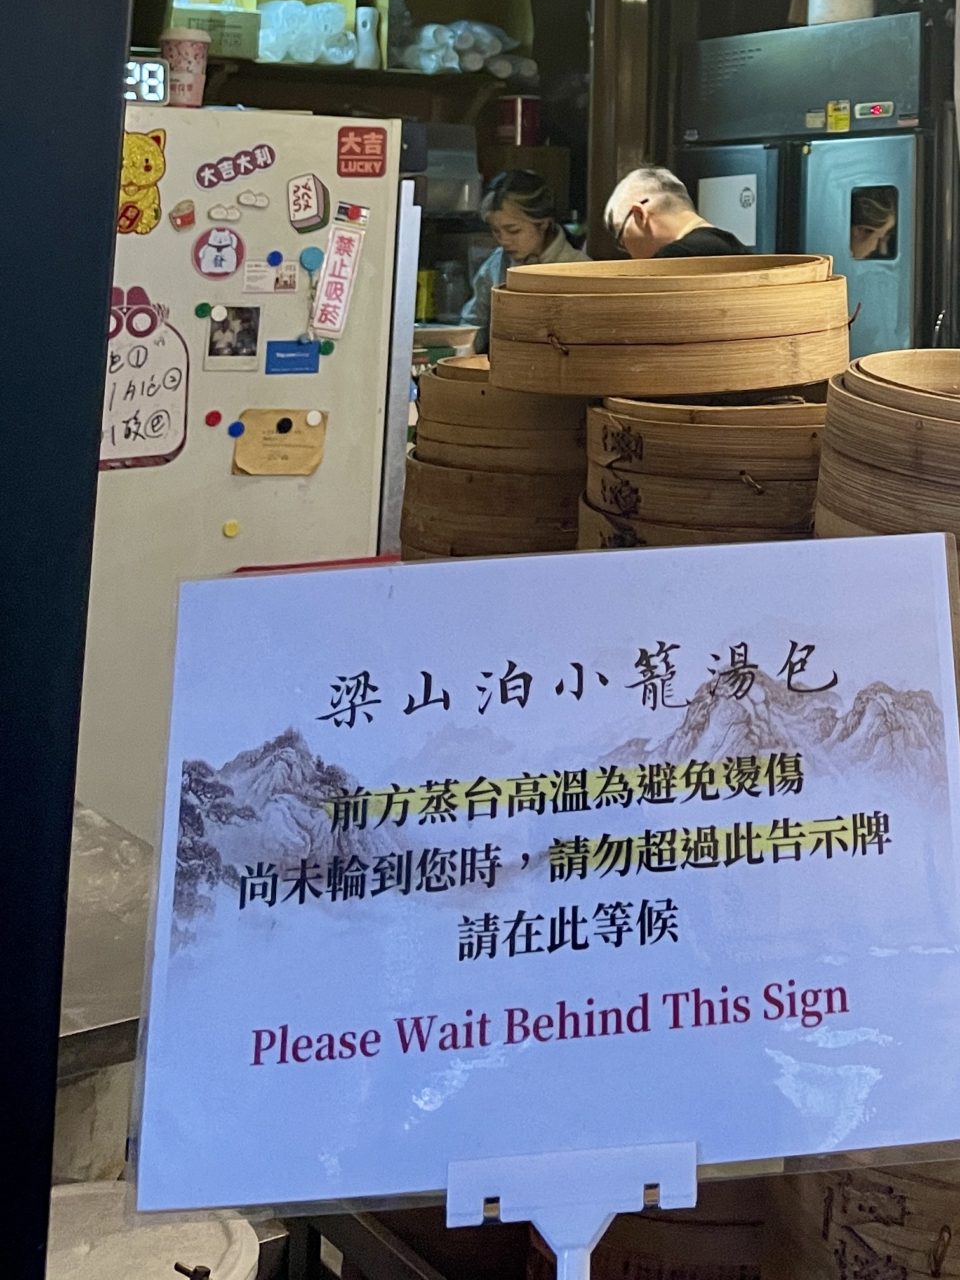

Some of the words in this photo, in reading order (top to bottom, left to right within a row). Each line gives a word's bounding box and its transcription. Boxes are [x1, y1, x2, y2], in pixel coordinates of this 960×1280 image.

[200, 146, 272, 187] 大吉大利
[340, 131, 384, 155] 大吉
[341, 161, 382, 173] LUCKY
[318, 235, 355, 326] 禁止吸菸
[315, 640, 838, 729] 梁山泊小籠湯包
[330, 752, 804, 830] 前方蒸台高溫為避免燙傷
[238, 810, 892, 910] 尚未輪到您時，請勿超過此告示牌
[457, 897, 680, 961] 請在此等候
[250, 1022, 381, 1066] Please
[395, 1011, 491, 1053] Wait
[505, 993, 651, 1044] Behind
[662, 985, 751, 1031] This
[762, 978, 850, 1028] Sign
